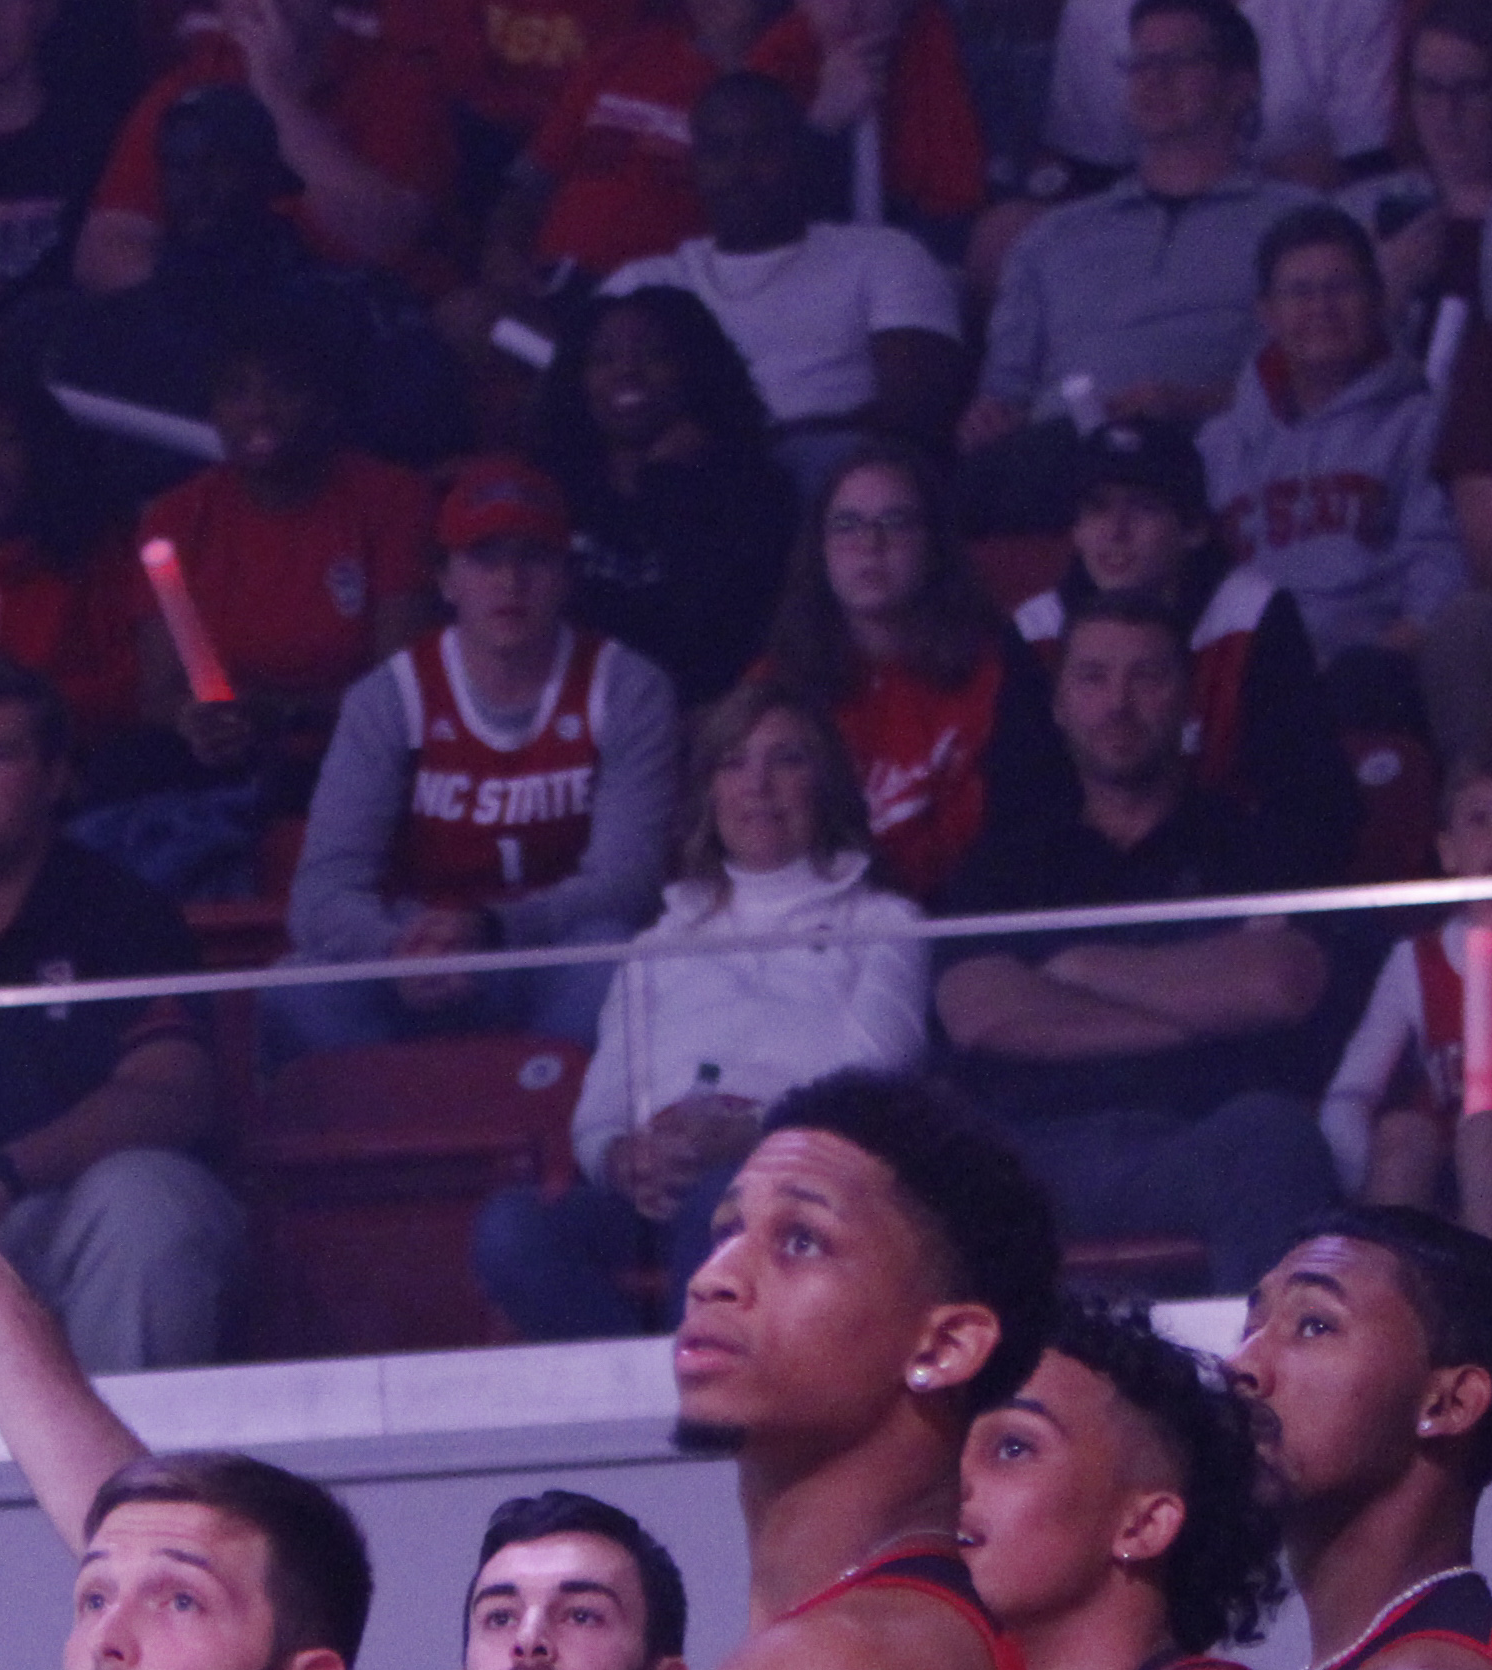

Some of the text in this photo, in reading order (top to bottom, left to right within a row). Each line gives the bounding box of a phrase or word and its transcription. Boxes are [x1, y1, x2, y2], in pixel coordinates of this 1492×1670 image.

[412, 766, 593, 826] NC STATE
[496, 837, 523, 883] 1
